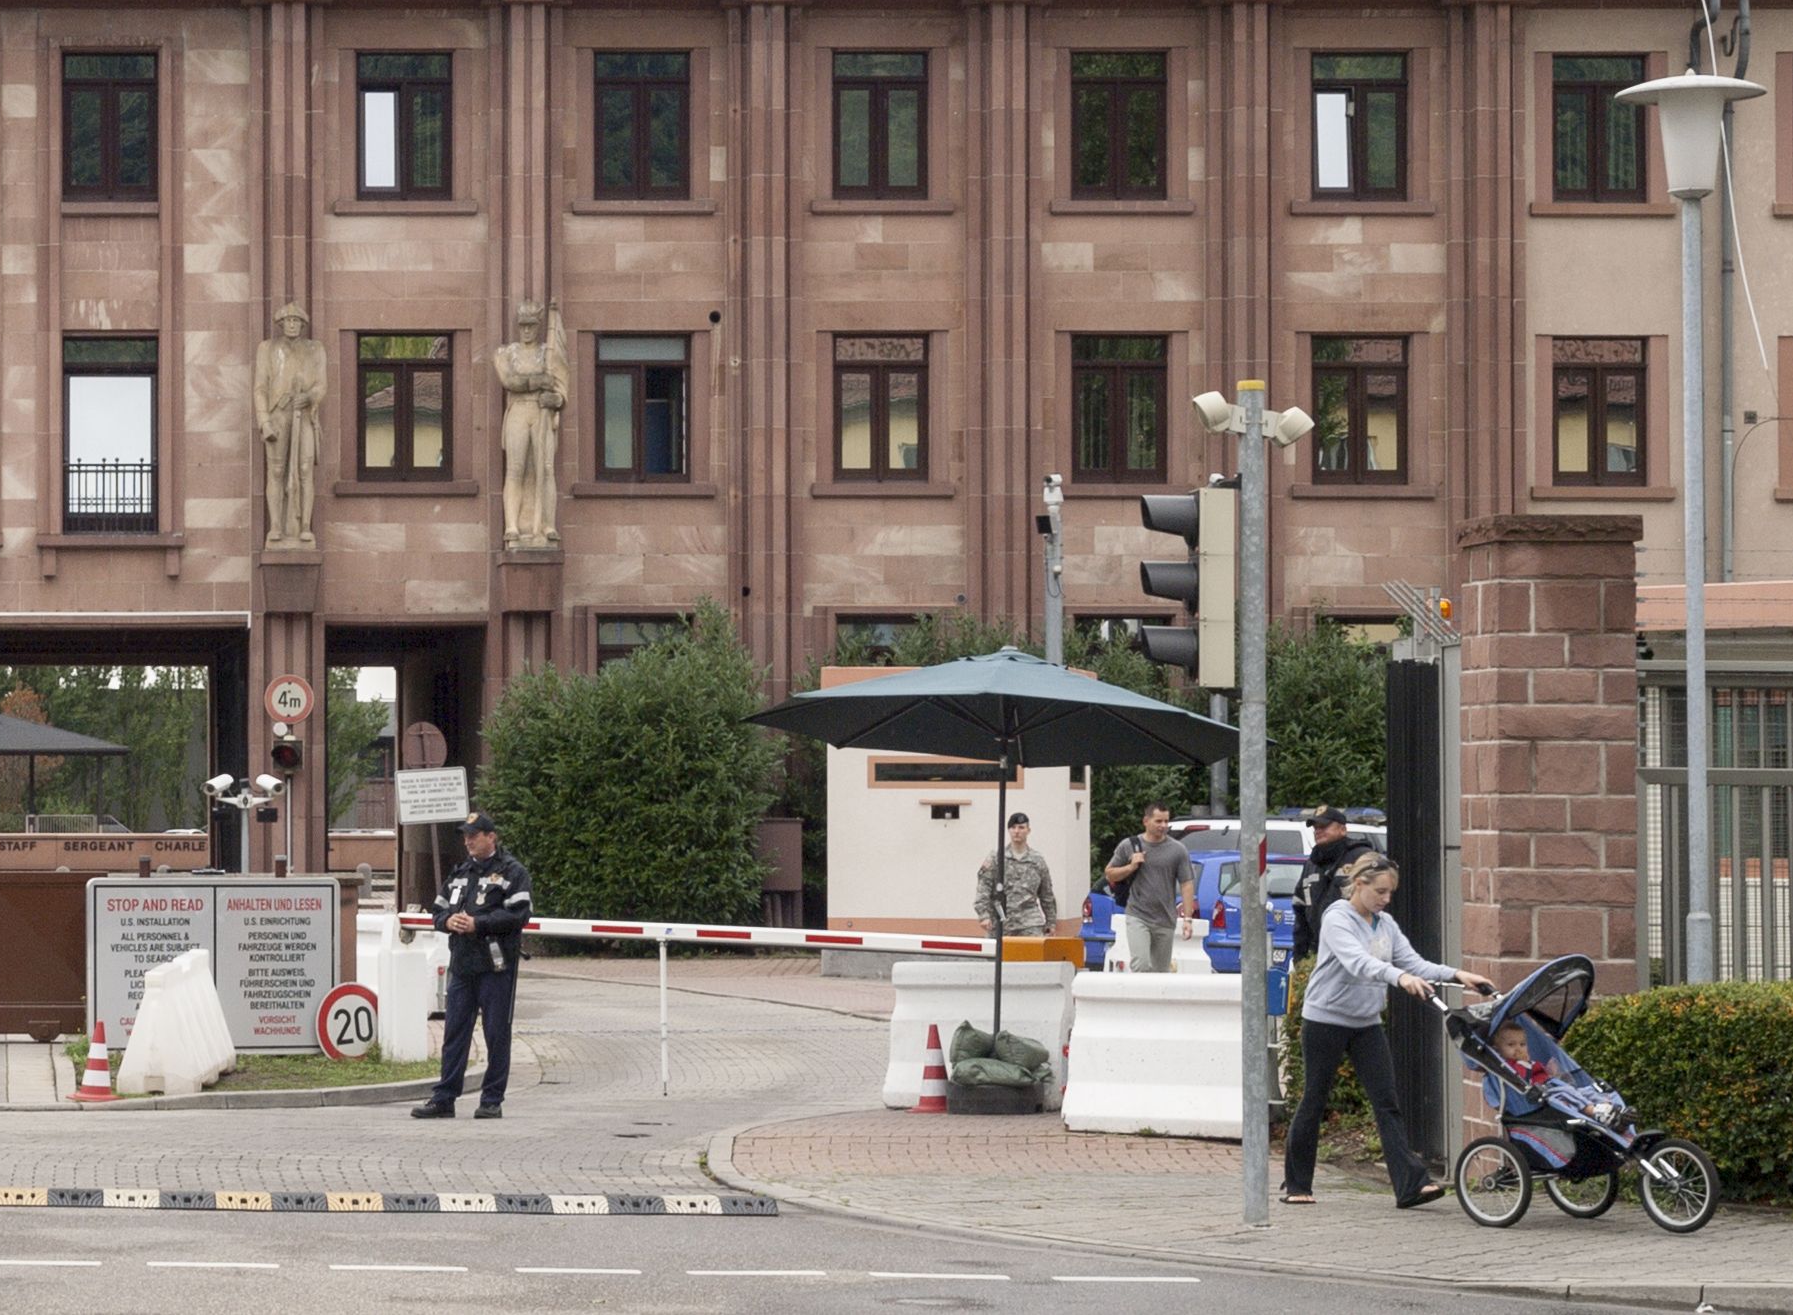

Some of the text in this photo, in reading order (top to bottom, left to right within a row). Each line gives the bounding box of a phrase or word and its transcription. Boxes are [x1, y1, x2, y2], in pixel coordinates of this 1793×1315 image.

[64, 841, 134, 852] SERGEANT
[107, 899, 204, 911] STOP AND READ
[227, 898, 322, 911] ANHALTEN UND LESEN
[120, 918, 190, 926] U.S. INSTALLATION
[244, 917, 311, 926] U.S. EINRICHTUNG
[121, 932, 135, 941] ALL
[137, 932, 182, 941] PERSONNEL
[248, 932, 306, 940] PERSONEN UND
[111, 944, 147, 952] VEHICLES
[149, 944, 164, 952] ARE
[238, 943, 317, 951] FAHRZEUGE WERDEN
[134, 955, 144, 963] TO
[249, 953, 305, 962] KONTROLLIERT
[248, 968, 306, 978] BITTE AUSWEIS,
[240, 977, 315, 988] FÜHRERSCHEIN UND
[244, 989, 311, 998] FAHRZEUGSCHEIN
[250, 1001, 305, 1010] BEREITHALTEN
[259, 1015, 296, 1024] VORSICHT
[253, 1026, 301, 1035] WACHHUNDE
[334, 1006, 373, 1046] 20
